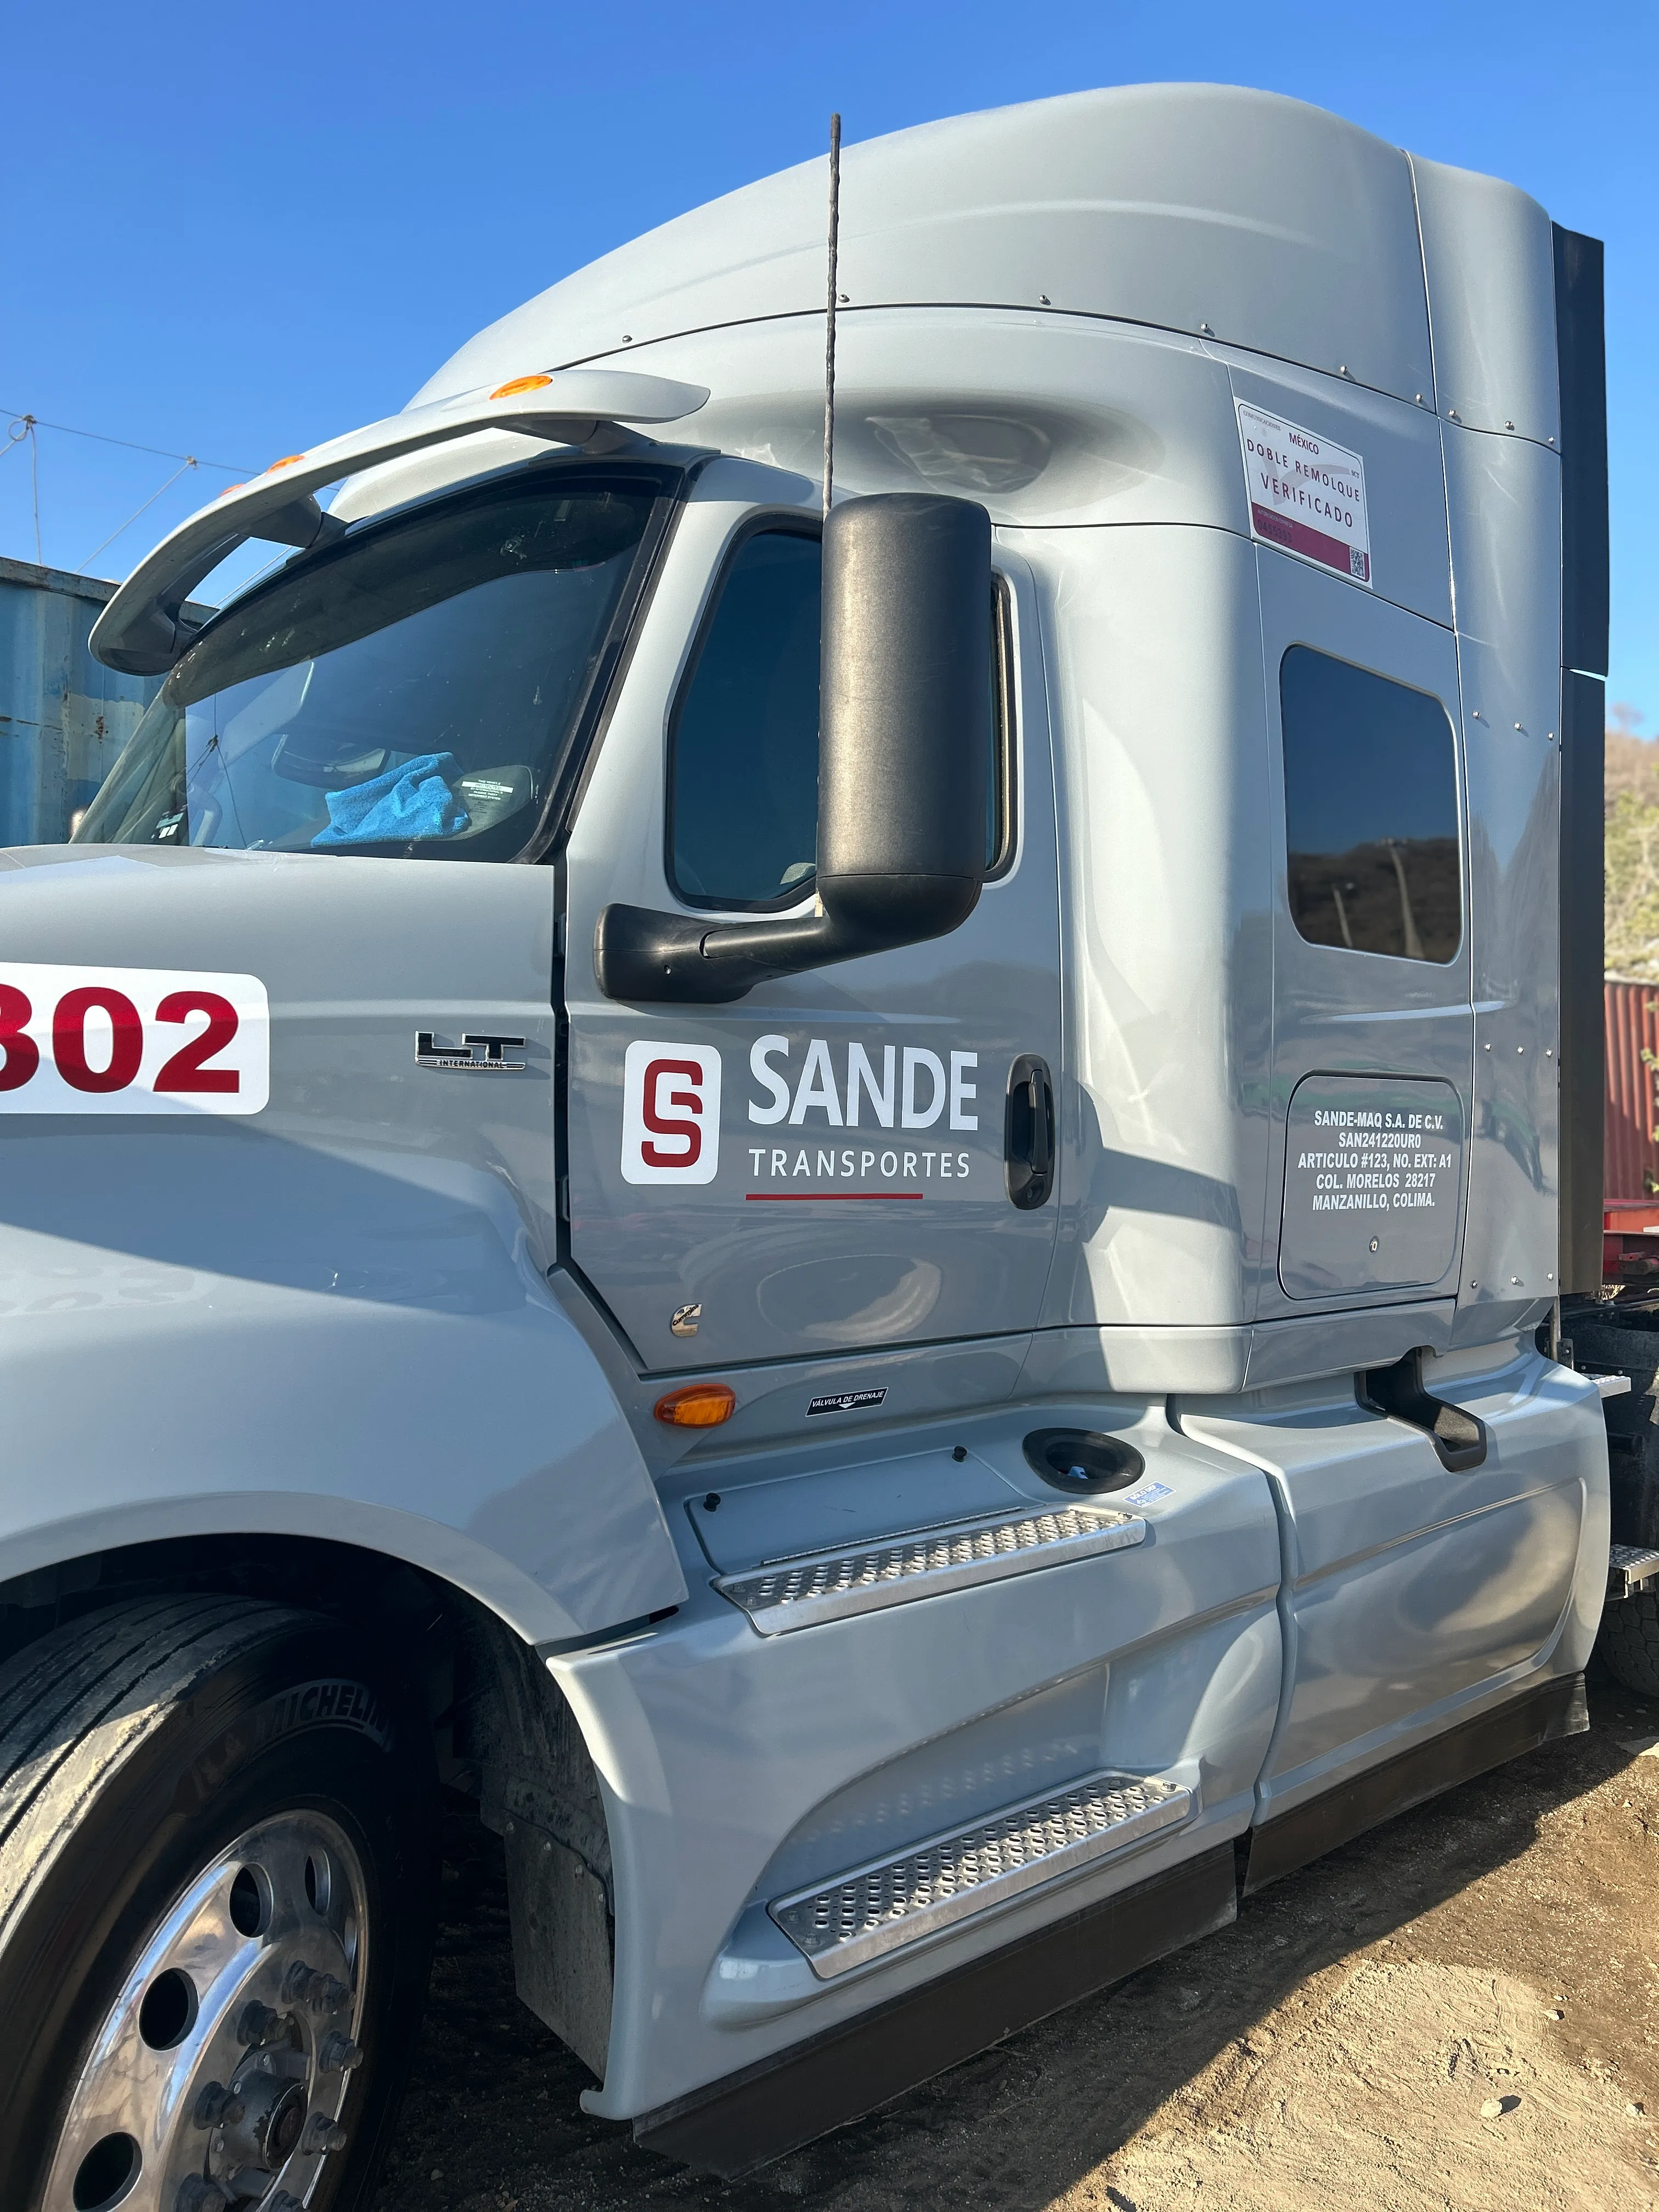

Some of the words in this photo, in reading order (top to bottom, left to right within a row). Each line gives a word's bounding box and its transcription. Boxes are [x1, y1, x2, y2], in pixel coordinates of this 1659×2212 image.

[1289, 432, 1319, 455] MÉXICO
[1247, 438, 1288, 468] DOBLE
[1295, 460, 1360, 502] REMOLQUE
[1261, 472, 1352, 528] VERIFICADO
[415, 1030, 527, 1061] LT
[440, 1060, 504, 1069] INTERNATIONAL
[748, 1034, 978, 1131] SANDE
[1314, 1110, 1382, 1130] SANDE-MAQ
[1385, 1113, 1406, 1128] S.A.
[1408, 1114, 1423, 1129] DE
[1424, 1115, 1443, 1130] C.V.
[748, 1149, 970, 1178] TRANSPORTES
[1297, 1153, 1358, 1169] ARTICULO
[1361, 1153, 1390, 1171] #123,
[1393, 1153, 1412, 1169] NO.
[1414, 1153, 1437, 1169] EXT:
[1438, 1154, 1452, 1168] A1
[1316, 1173, 1343, 1189] COL.
[1346, 1173, 1400, 1189] MORELOS
[1404, 1172, 1436, 1188] 28217
[1312, 1193, 1390, 1211] MANZANILLO,
[1393, 1192, 1435, 1208] COLIMA.
[672, 1304, 699, 1326] Cummins
[812, 1398, 842, 1407] VÁLVULA
[843, 1395, 854, 1403] DE
[853, 1391, 884, 1401] DRENAJE
[261, 1684, 388, 1739] MICHELIN
